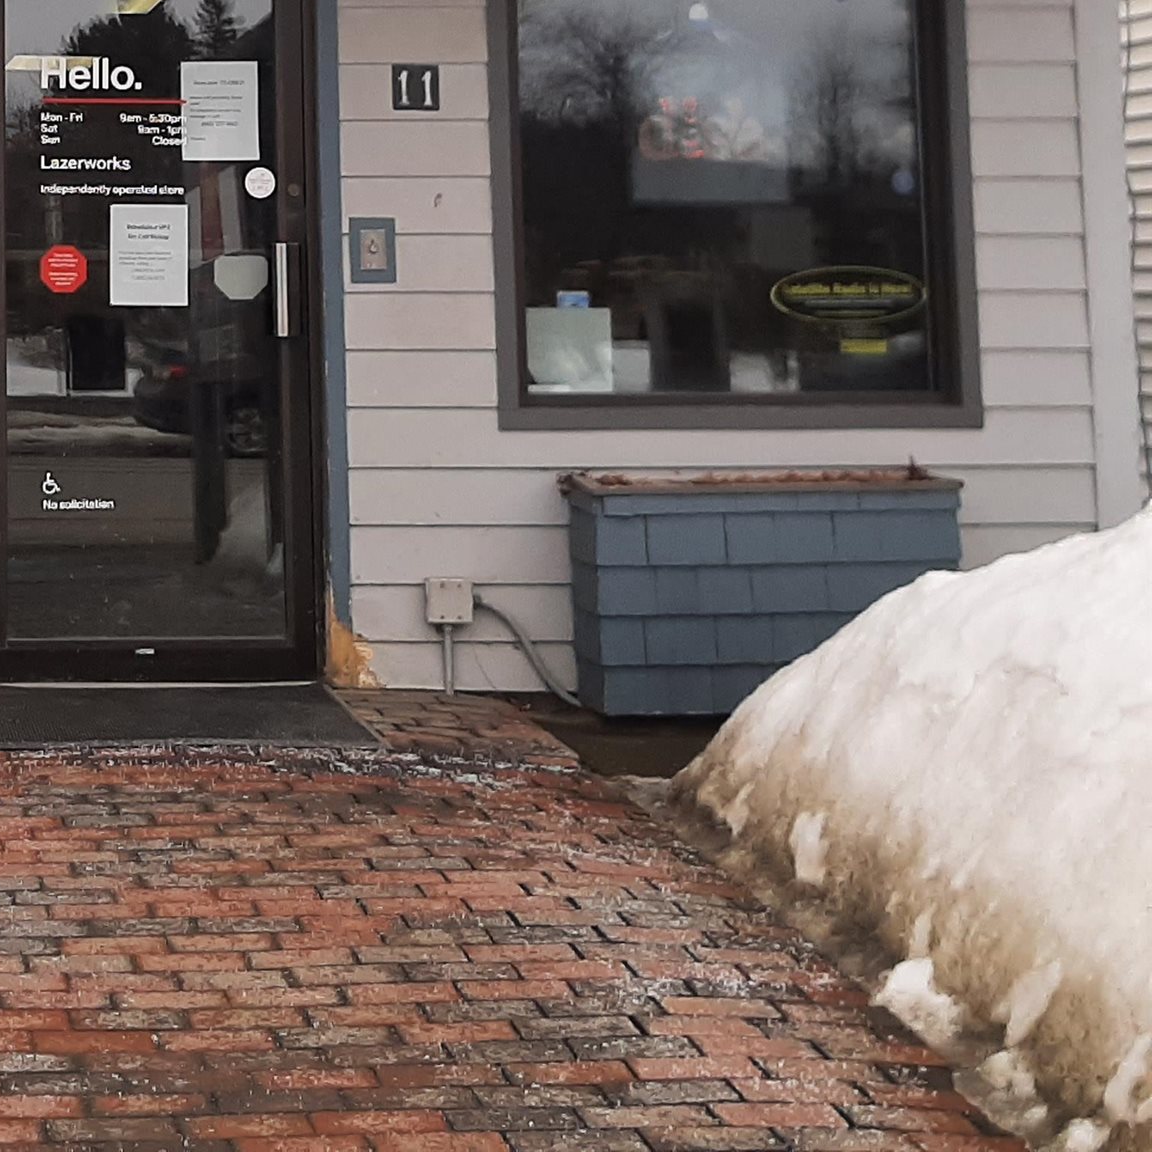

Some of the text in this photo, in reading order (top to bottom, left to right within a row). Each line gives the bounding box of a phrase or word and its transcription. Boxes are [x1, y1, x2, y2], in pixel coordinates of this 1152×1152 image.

[40, 56, 142, 90] Hello.
[398, 70, 433, 106] 11
[40, 112, 63, 122] Mon
[69, 112, 84, 123] Fri
[40, 123, 58, 134] Sat
[40, 134, 61, 145] Sun
[152, 135, 187, 146] Closed
[40, 155, 132, 171] Lazerworks
[40, 183, 184, 196] Independently operated store
[42, 498, 114, 510] No solicitation
